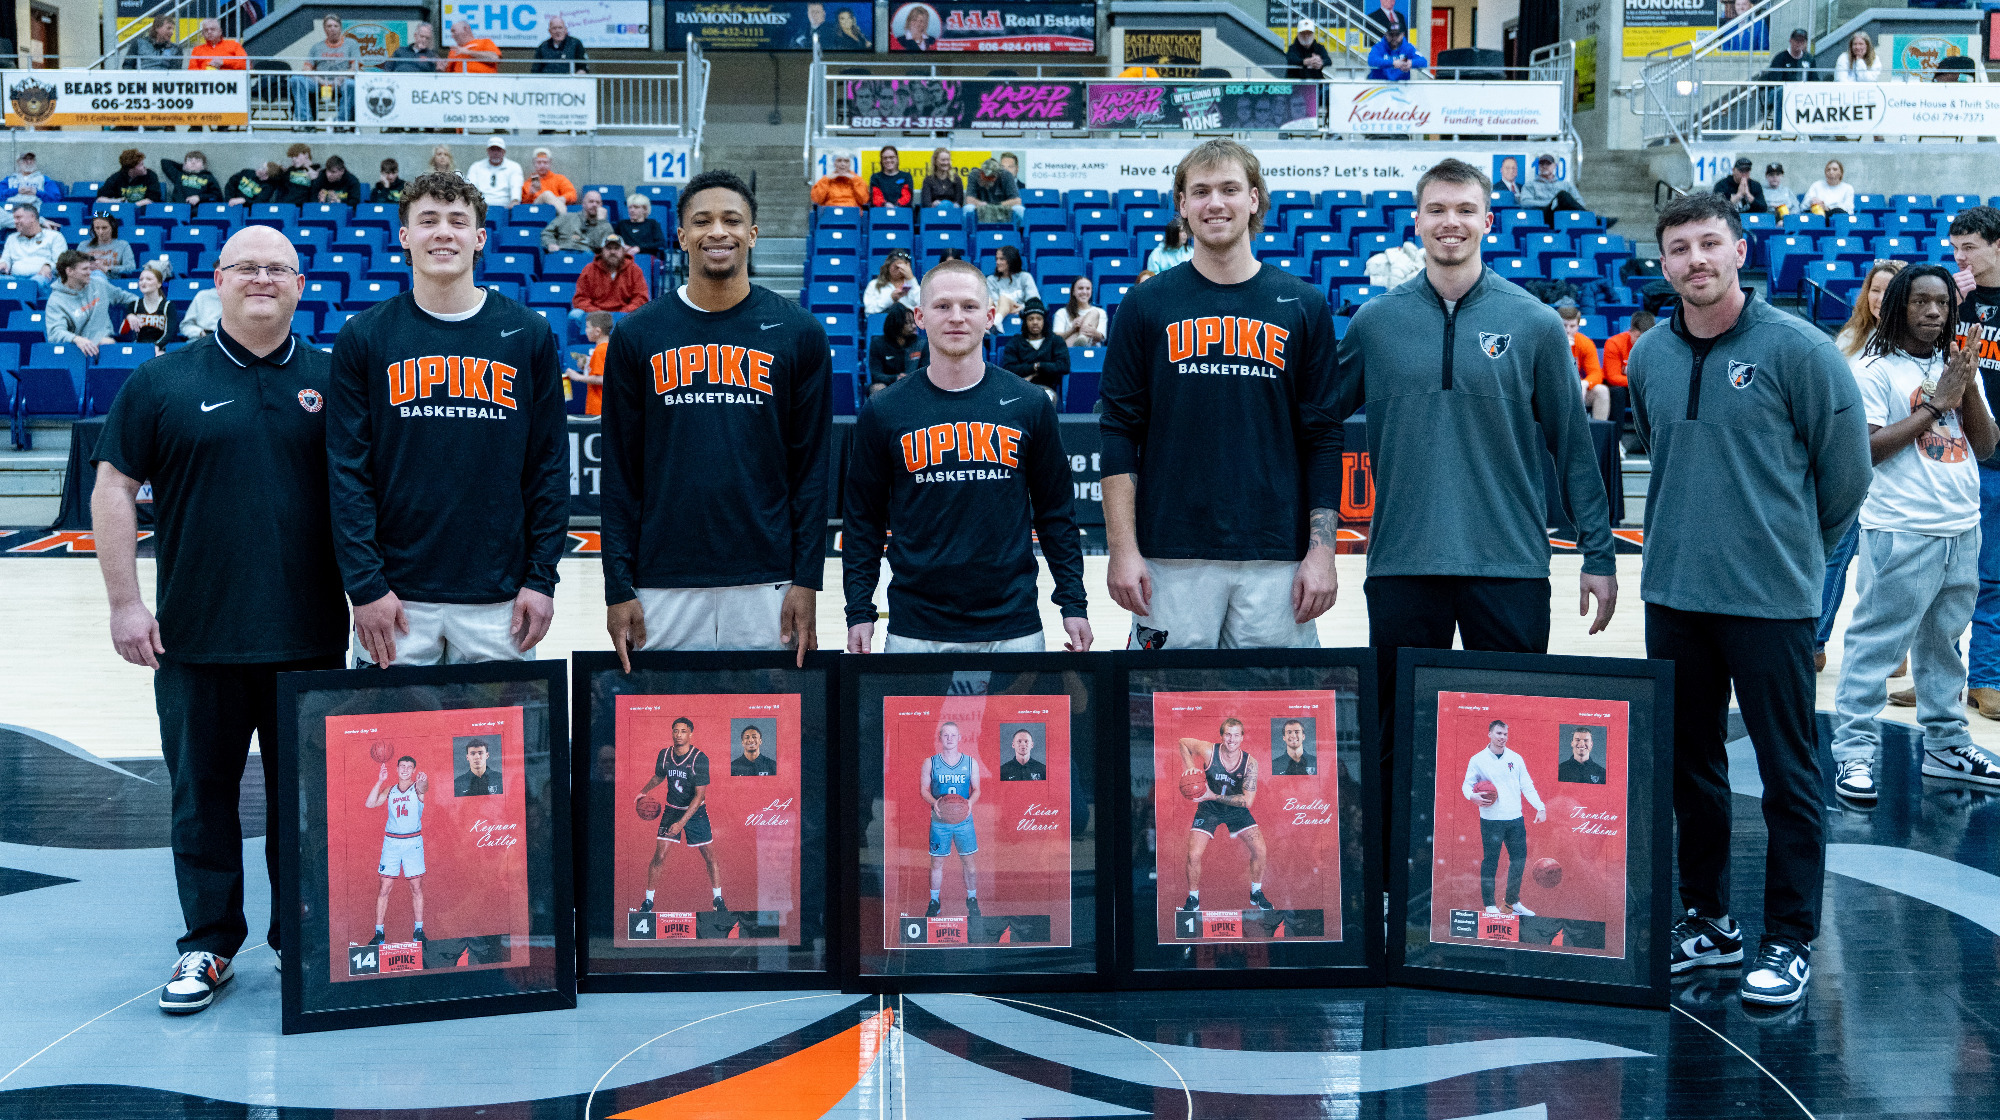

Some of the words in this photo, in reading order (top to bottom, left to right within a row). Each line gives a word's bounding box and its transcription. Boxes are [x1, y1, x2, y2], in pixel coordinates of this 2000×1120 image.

[1626, 0, 1705, 10] HONORED
[675, 12, 743, 24] RAYMOND
[743, 12, 788, 25] JAMES
[946, 10, 1004, 31] AAA
[1005, 14, 1041, 28] Real
[1044, 14, 1095, 28] Estate
[1150, 34, 1200, 45] KENTUCKY
[64, 82, 112, 95] BEARS
[118, 82, 147, 95] DEN
[152, 82, 238, 95] NUTRITION
[980, 85, 1072, 102] JADED
[91, 98, 194, 110] 606-253-3009
[412, 90, 463, 105] BEAR'S
[467, 92, 498, 105] DEN
[503, 92, 586, 106] NUTRITION
[1100, 86, 1166, 108] JADED
[1794, 89, 1877, 108] FAITHLIFE
[1887, 98, 1918, 109] Coffee
[1919, 98, 1947, 109] House
[1959, 98, 1983, 110] Thrift
[1985, 100, 2000, 110] Sto
[975, 101, 1069, 119] RAYNE
[1348, 104, 1431, 128] Kentucky
[1795, 104, 1877, 124] MARKET
[851, 116, 955, 129] 606-371-3153
[1182, 112, 1222, 131] DONE
[1352, 123, 1412, 132] LOTTERY
[1443, 116, 1484, 127] Funding
[1487, 116, 1540, 126] Education.
[648, 151, 687, 178] 121
[1032, 162, 1044, 171] JC
[1046, 162, 1079, 172] Hensley,
[1120, 163, 1158, 177] Have
[1334, 165, 1370, 178] Let's
[1373, 165, 1405, 178] talk.
[137, 313, 165, 331] EARS
[1166, 315, 1290, 372] UPIKE
[650, 343, 775, 396] UPIKE
[1178, 362, 1277, 379] BASKETBALL
[387, 355, 518, 411] UPIKE
[664, 392, 764, 406] BASKETBALL
[400, 405, 507, 420] BASKETBALL
[900, 421, 1022, 474] UPIKE
[915, 468, 1012, 484] BASKETBALL
[668, 769, 688, 780] UPIKE
[938, 774, 966, 784] UPIKE
[396, 803, 409, 819] 14
[762, 797, 794, 812] LA
[1023, 803, 1060, 817] Keian
[1282, 797, 1331, 815] Bradley
[744, 813, 790, 827] Walker
[1291, 812, 1332, 826] Bunch
[1569, 805, 1618, 821] Trenton
[469, 819, 518, 837] Keynan
[1572, 821, 1618, 837] Adkins
[476, 834, 518, 849] Cutlip
[635, 918, 650, 934] 4
[664, 923, 690, 934] UPIKE
[907, 922, 922, 939] 0
[936, 927, 961, 938] UPIKE
[1185, 917, 1195, 933] 1
[1211, 922, 1236, 933] UPIKE
[1486, 924, 1513, 936] UPIKE
[352, 952, 378, 970] 14
[388, 954, 416, 967] UPIKE
